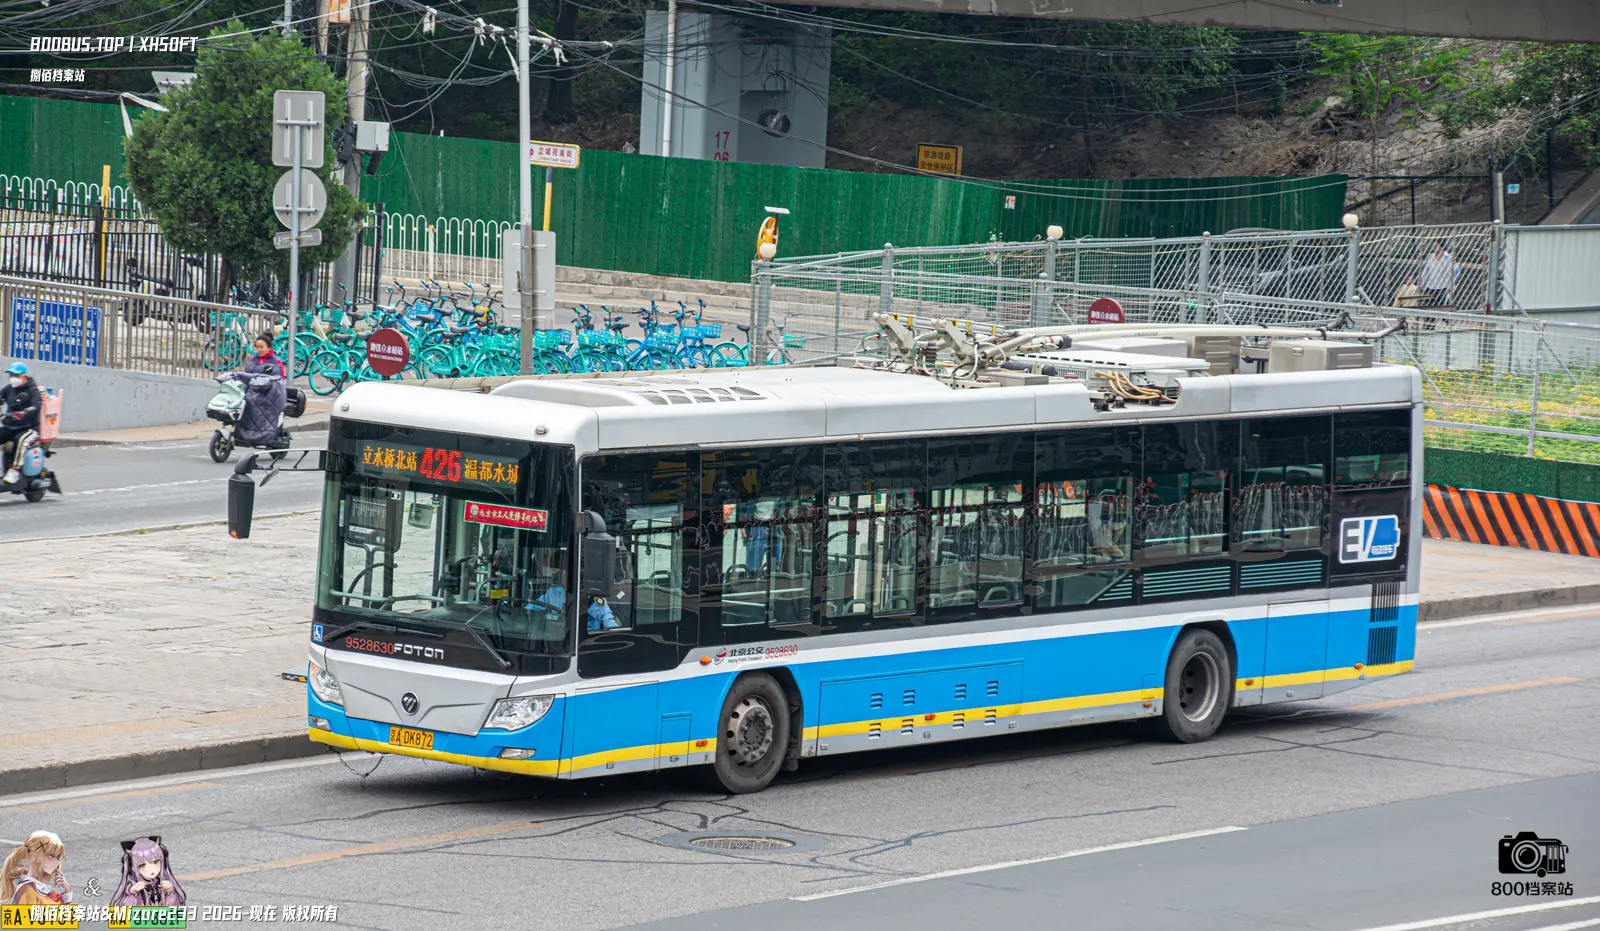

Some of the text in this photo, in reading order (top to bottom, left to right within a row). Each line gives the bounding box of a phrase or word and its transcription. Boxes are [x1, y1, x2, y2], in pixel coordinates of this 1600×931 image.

[714, 130, 731, 149] 17
[924, 150, 951, 160] 铁路线路
[371, 342, 403, 355] 地铁立水桥站
[362, 446, 520, 484] 立水桥北站 426 温都水城
[345, 636, 444, 659] 9528630 FOTON
[730, 644, 798, 659] 北京公交 9528630
